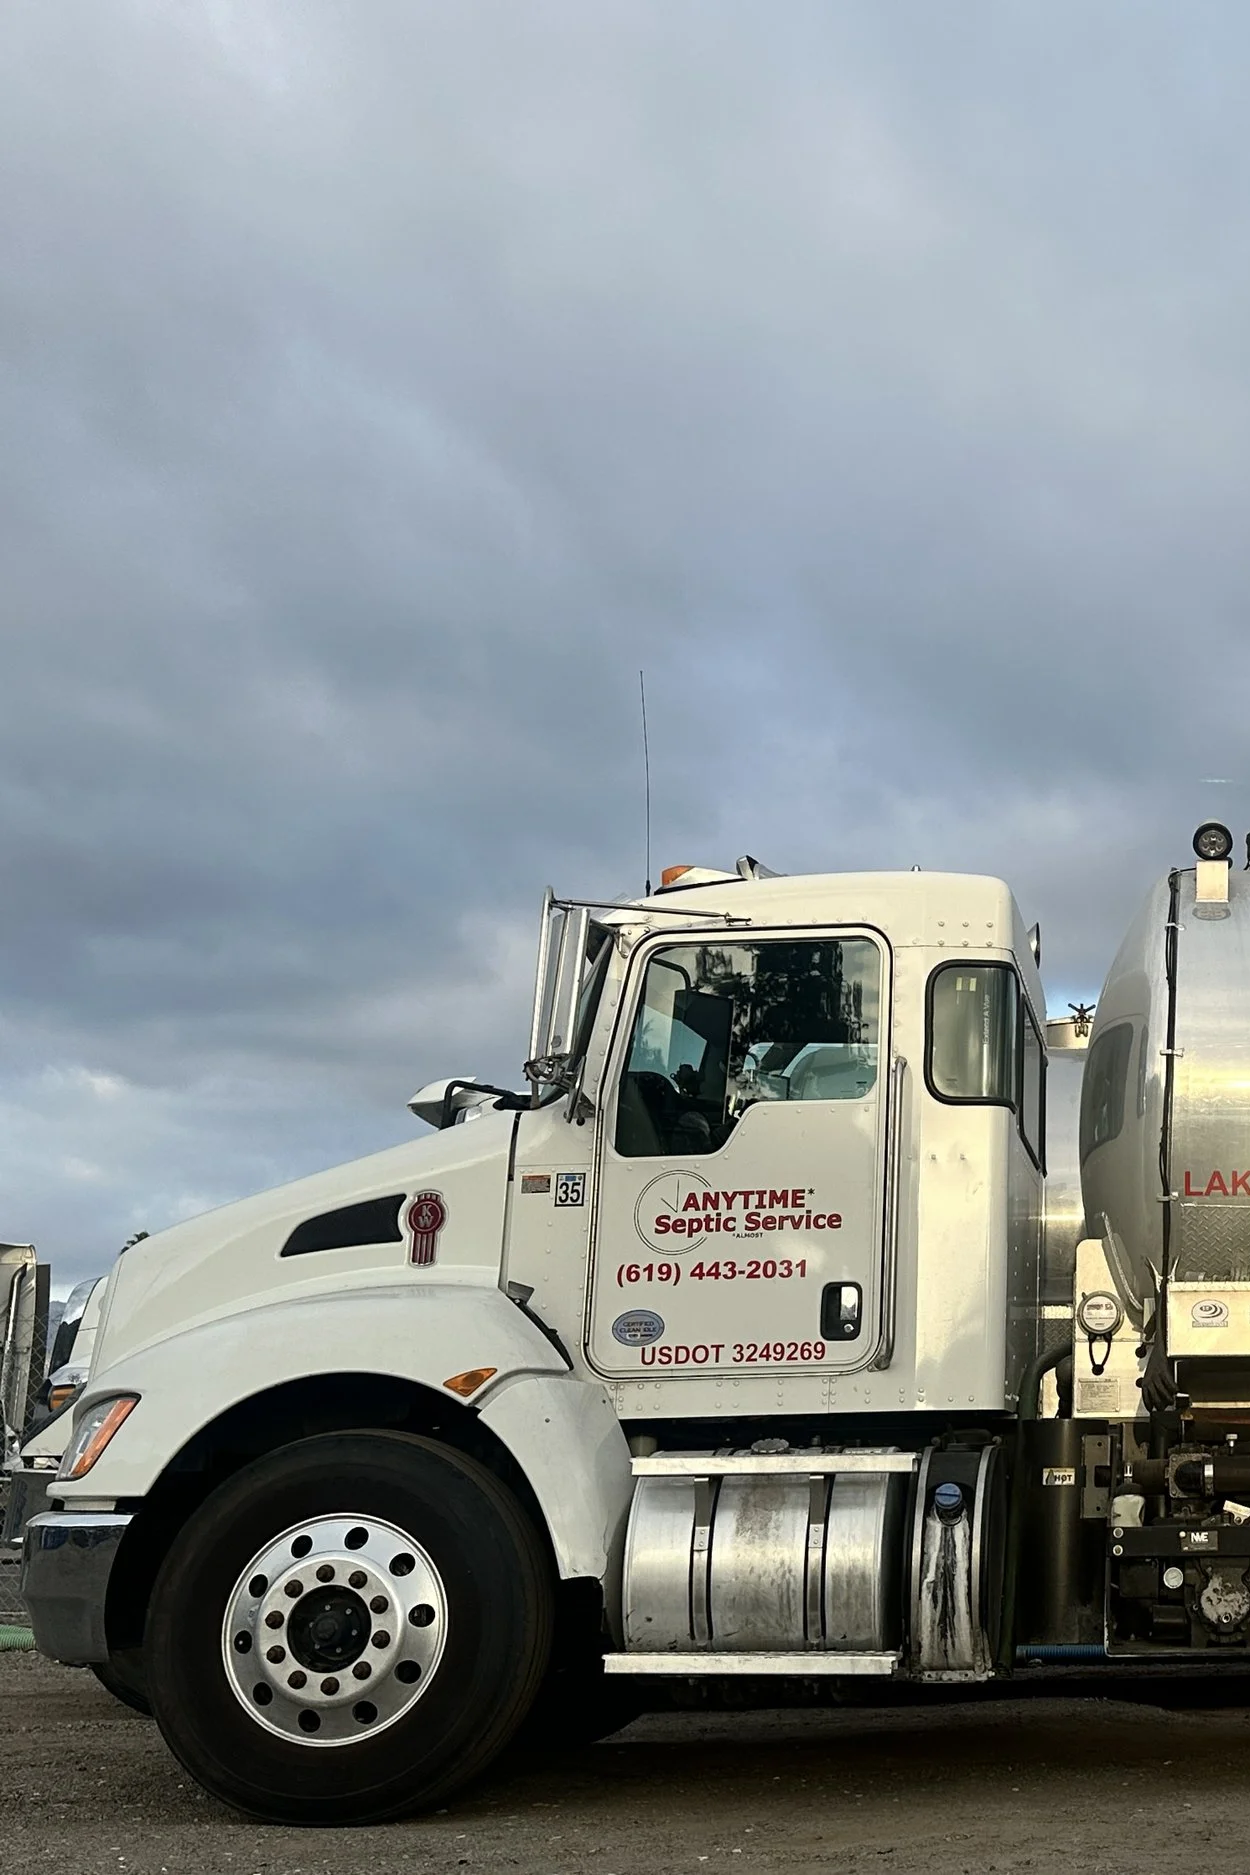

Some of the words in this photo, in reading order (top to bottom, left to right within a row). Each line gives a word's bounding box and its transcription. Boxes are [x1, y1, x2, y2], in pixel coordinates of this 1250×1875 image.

[558, 1182, 580, 1203] 35
[654, 1212, 737, 1238] Septic
[744, 1210, 842, 1232] Service
[616, 1262, 681, 1288] (619)
[690, 1259, 808, 1281] 443-2031
[640, 1344, 725, 1366] USDOT
[732, 1341, 826, 1363] 3249269
[1054, 1474, 1072, 1482] HOT
[1190, 1532, 1209, 1543] NVE
